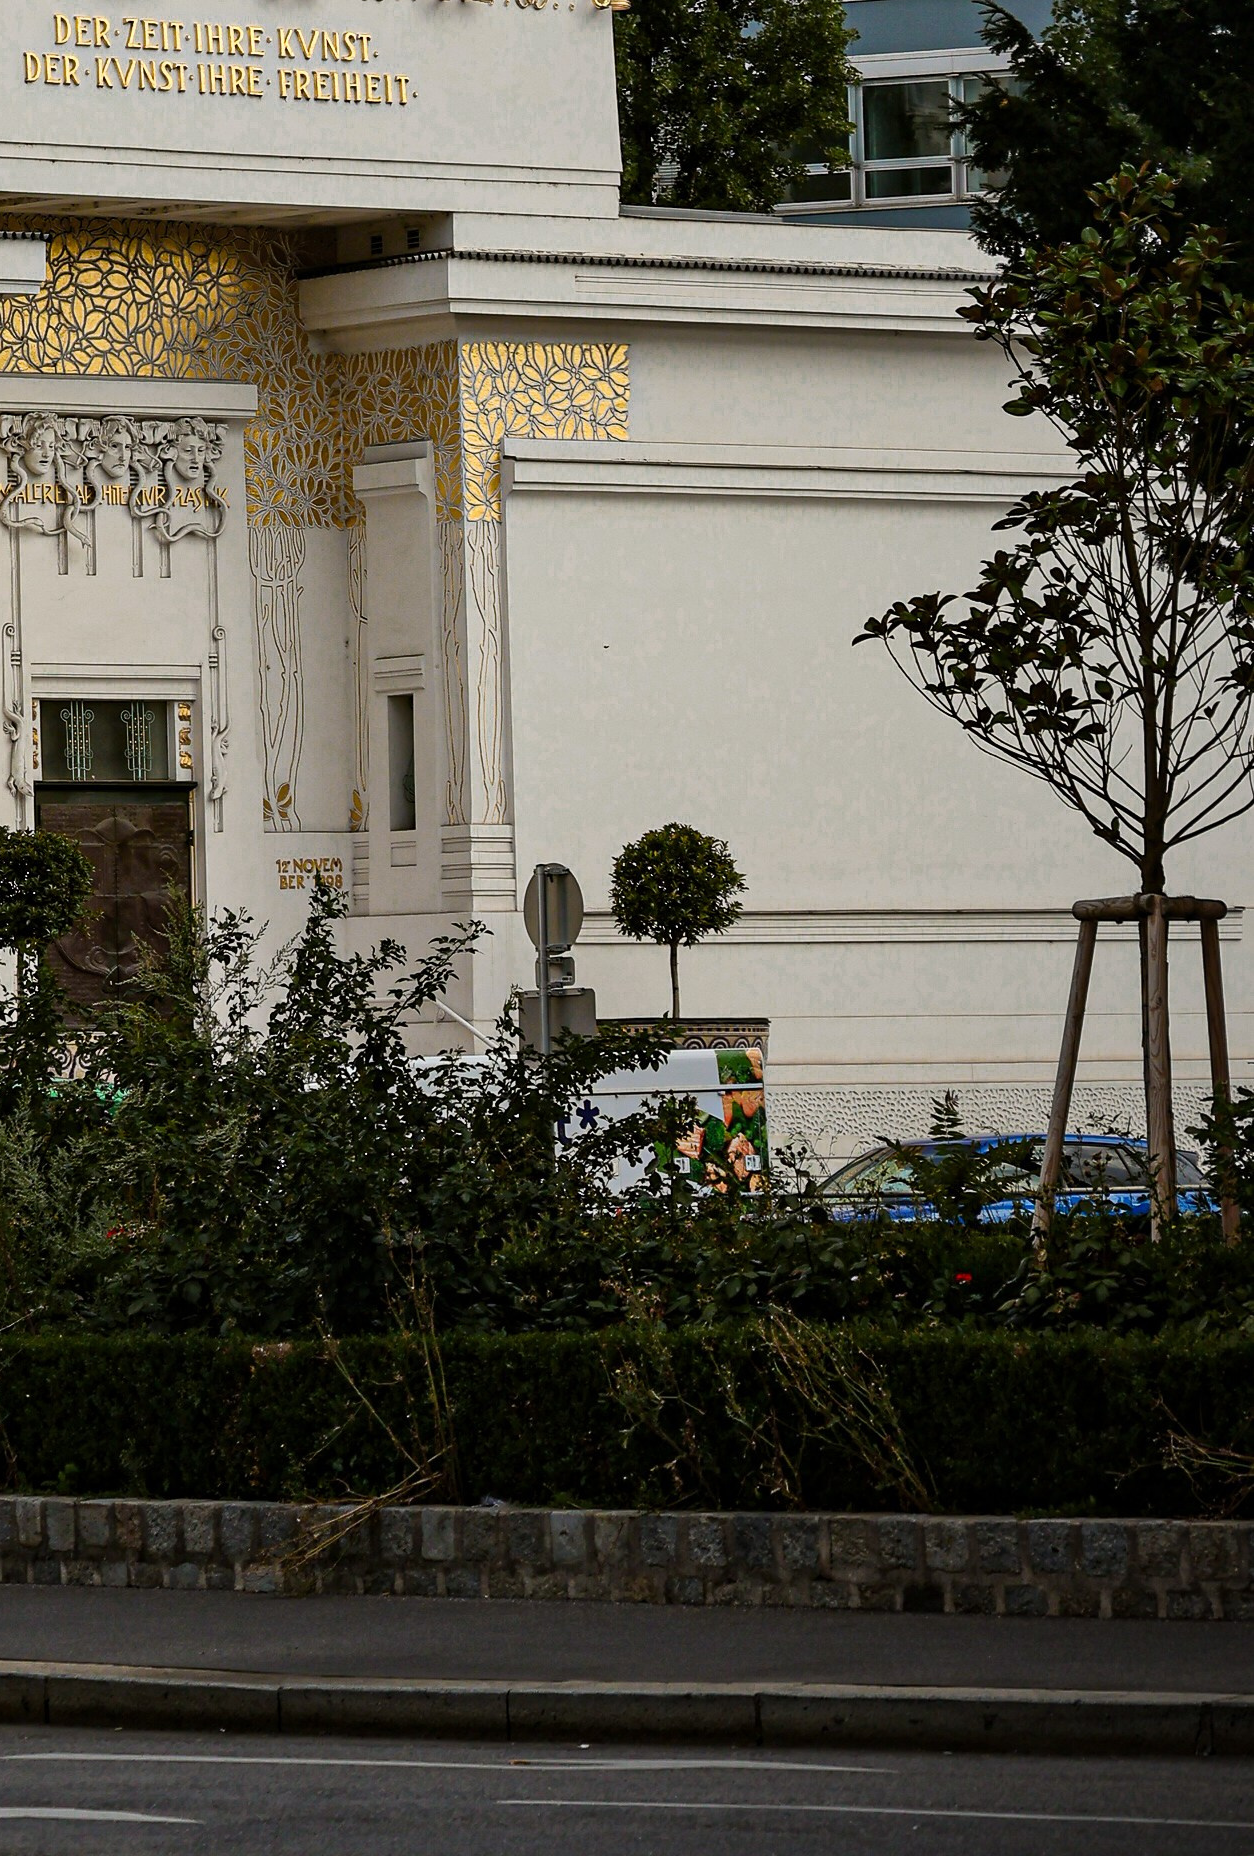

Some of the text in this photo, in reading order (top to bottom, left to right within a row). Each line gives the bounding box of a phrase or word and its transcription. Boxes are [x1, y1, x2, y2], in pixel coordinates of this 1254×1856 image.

[53, 13, 111, 48] DER
[122, 17, 184, 52] ZEIT
[194, 21, 266, 57] IHRE
[23, 52, 80, 87] DER
[95, 56, 188, 94] KVNST
[197, 63, 264, 97] IHRE
[172, 486, 230, 513] PLASK
[293, 857, 343, 874] NOVEM
[279, 874, 306, 890] BER
